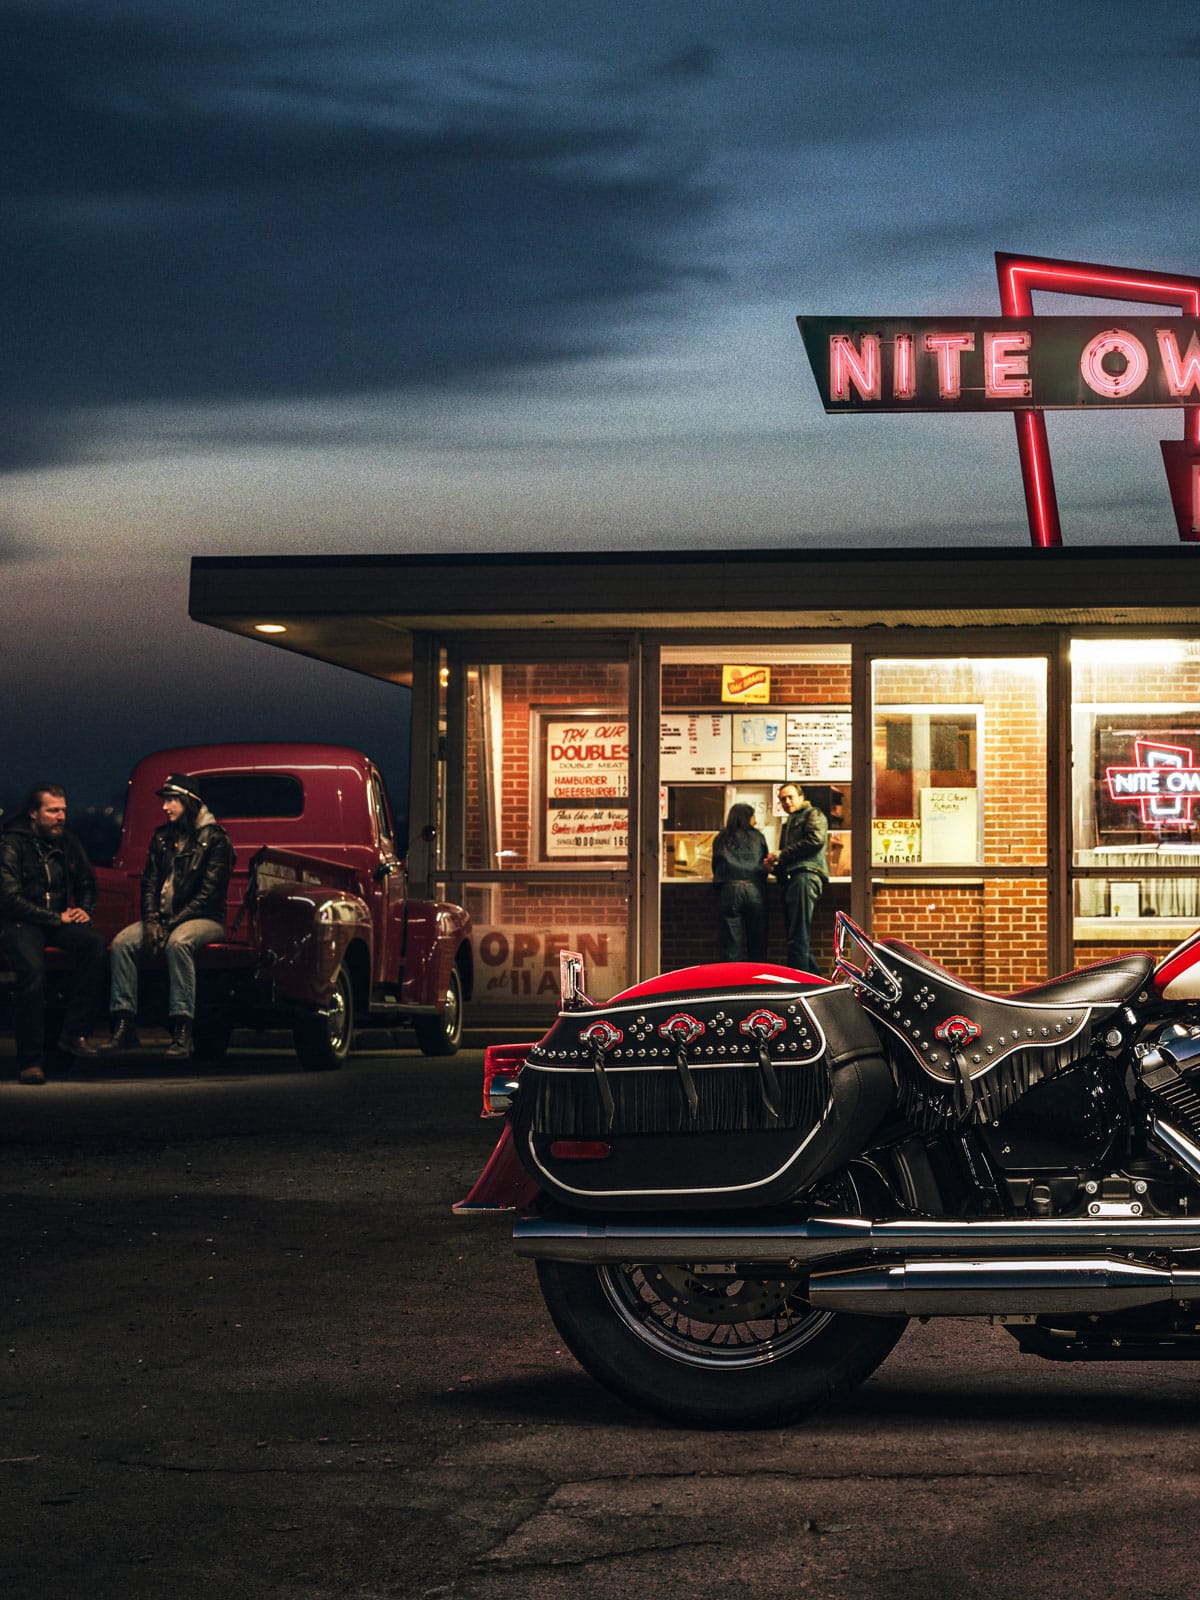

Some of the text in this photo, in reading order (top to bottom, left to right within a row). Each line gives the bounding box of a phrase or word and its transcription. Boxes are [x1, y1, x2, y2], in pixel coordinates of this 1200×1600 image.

[830, 331, 1032, 401] NITE
[562, 725, 627, 744] TRY OUR
[551, 745, 629, 760] DOUBLES
[554, 776, 607, 785] HAMBURGER
[1115, 773, 1160, 793] NITE
[873, 821, 887, 829] ICE
[480, 932, 608, 967] OPEN
